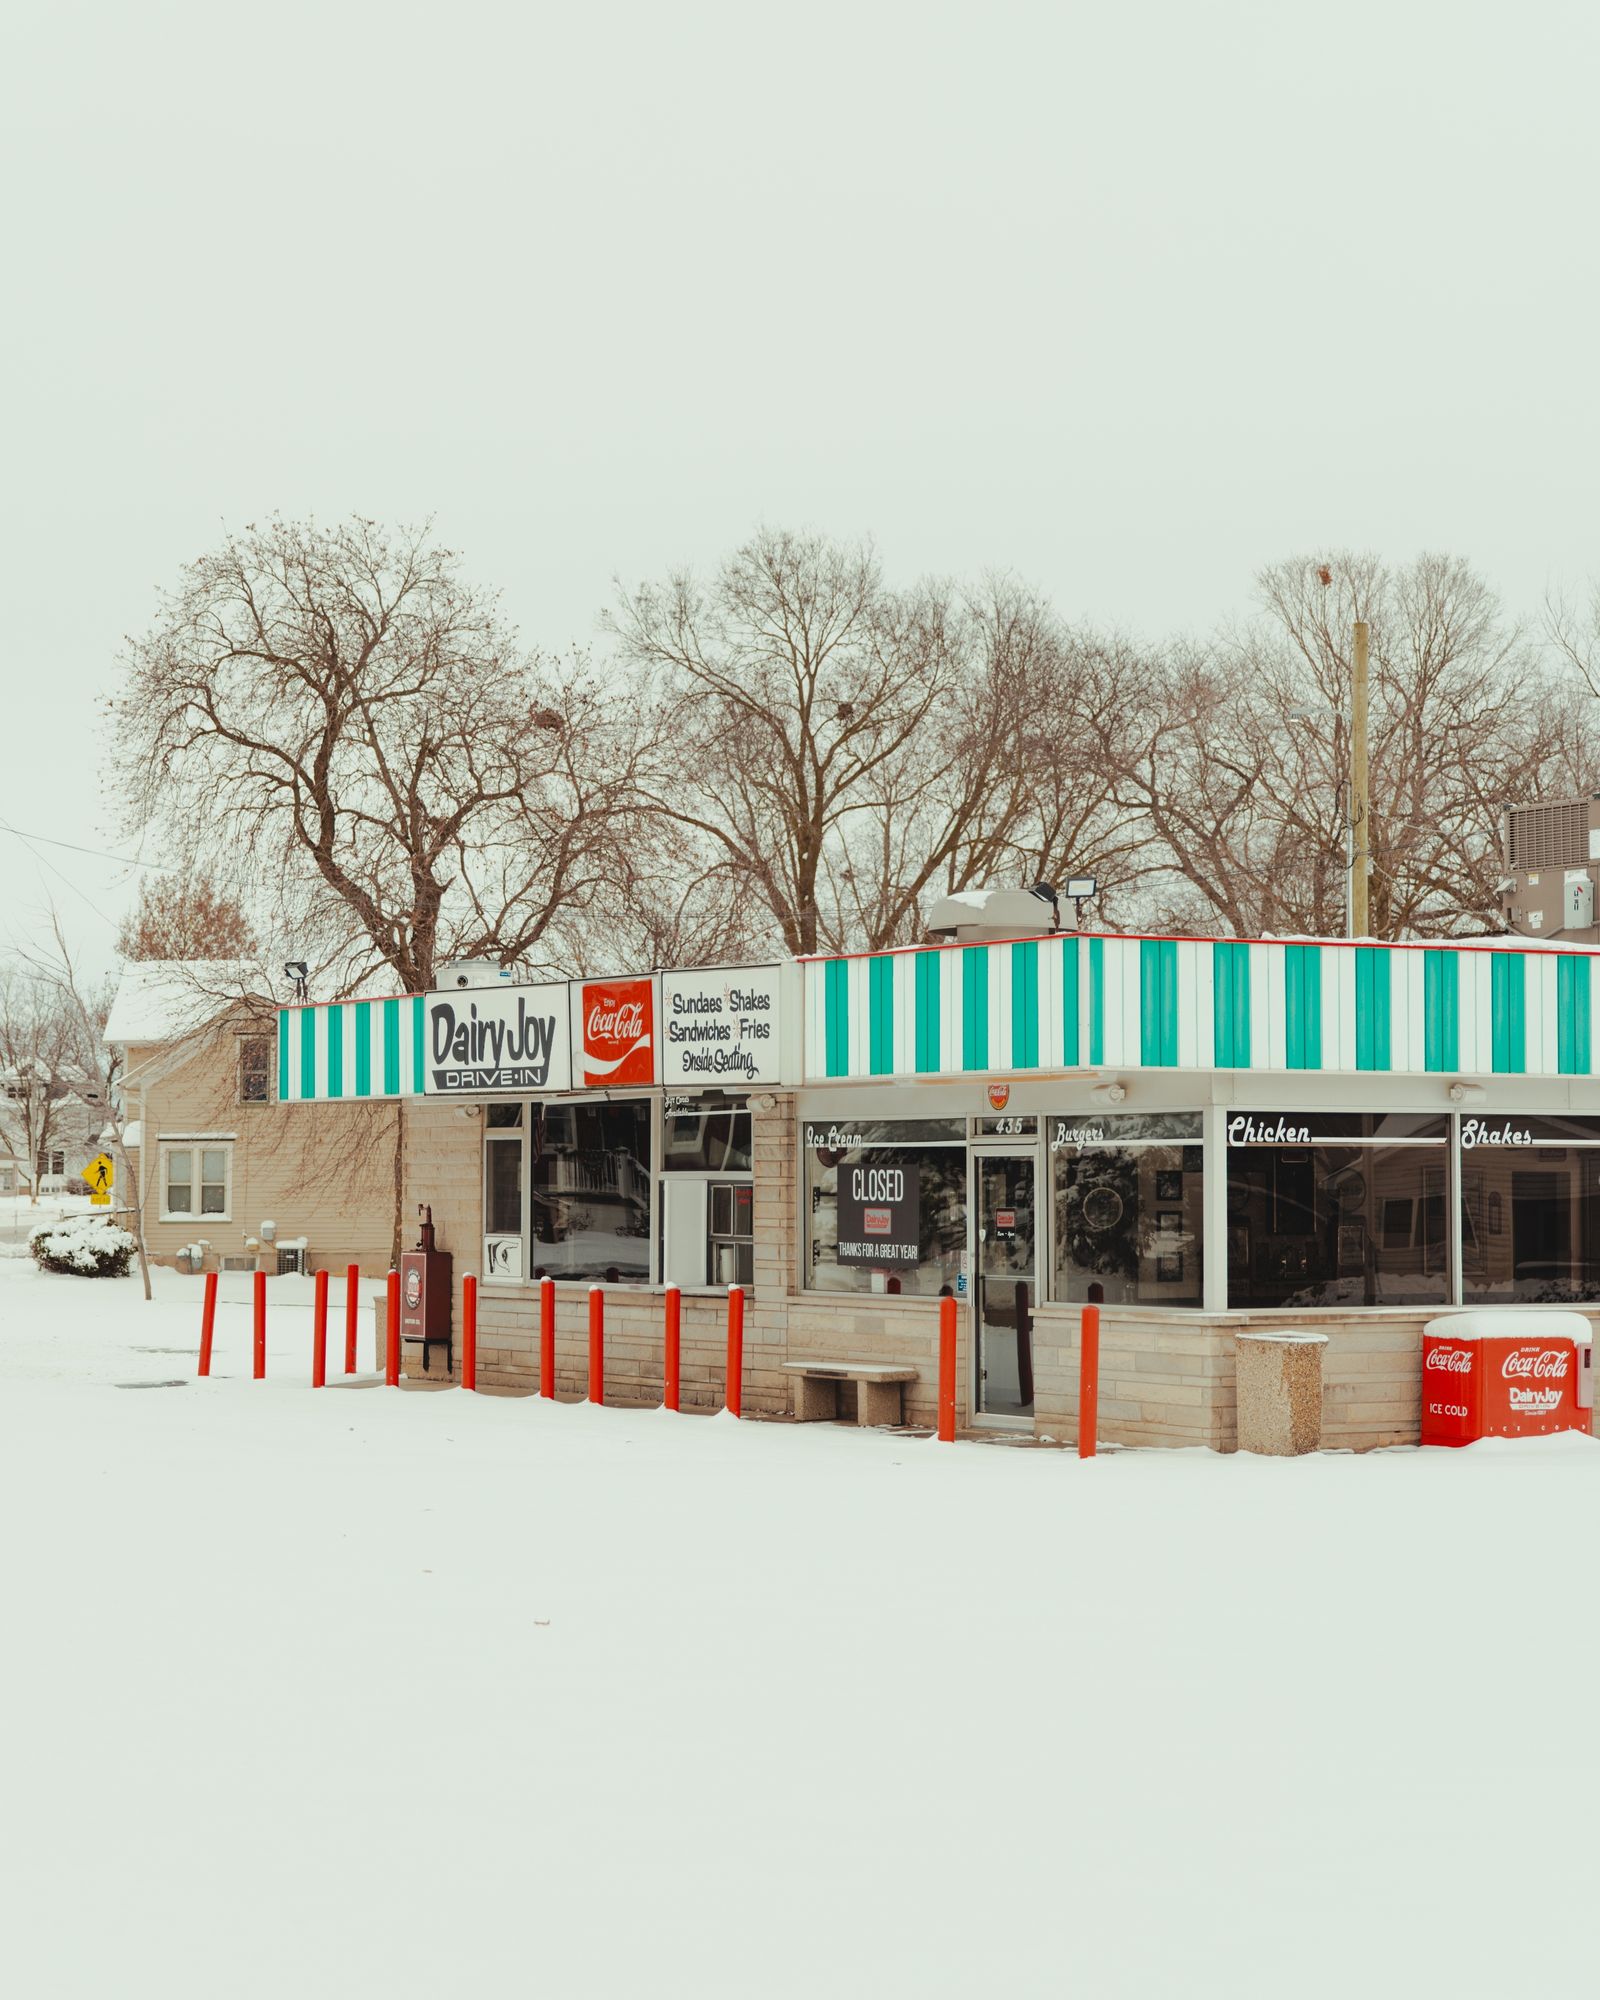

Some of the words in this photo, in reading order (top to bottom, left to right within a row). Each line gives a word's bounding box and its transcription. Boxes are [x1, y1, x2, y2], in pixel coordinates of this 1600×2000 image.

[603, 998, 616, 1008] Enjoy
[673, 991, 722, 1014] Sundaes
[729, 988, 770, 1012] Shakes
[587, 1002, 644, 1041] Coca-Cola
[669, 1019, 731, 1042] Sandwiches
[739, 1018, 770, 1039] Fries
[682, 1047, 713, 1072] Inside
[713, 1042, 759, 1080] Seating
[807, 1126, 824, 1147] Ice
[827, 1125, 862, 1152] Cream
[995, 1117, 1023, 1134] 435
[1051, 1122, 1104, 1151] Burgers
[1228, 1116, 1310, 1147] Chicken
[1461, 1119, 1532, 1149] Shakes
[852, 1169, 904, 1202] CLOSED
[838, 1242, 862, 1257] THANKS
[862, 1243, 874, 1257] FOR
[874, 1243, 880, 1258] A
[880, 1244, 899, 1259] GREAT
[900, 1245, 918, 1260] YEAR!
[1426, 1348, 1474, 1373] Coca-Cola
[1502, 1351, 1571, 1378] Coca-Cola
[1429, 1403, 1442, 1415] ICE
[1445, 1404, 1468, 1417] COLD
